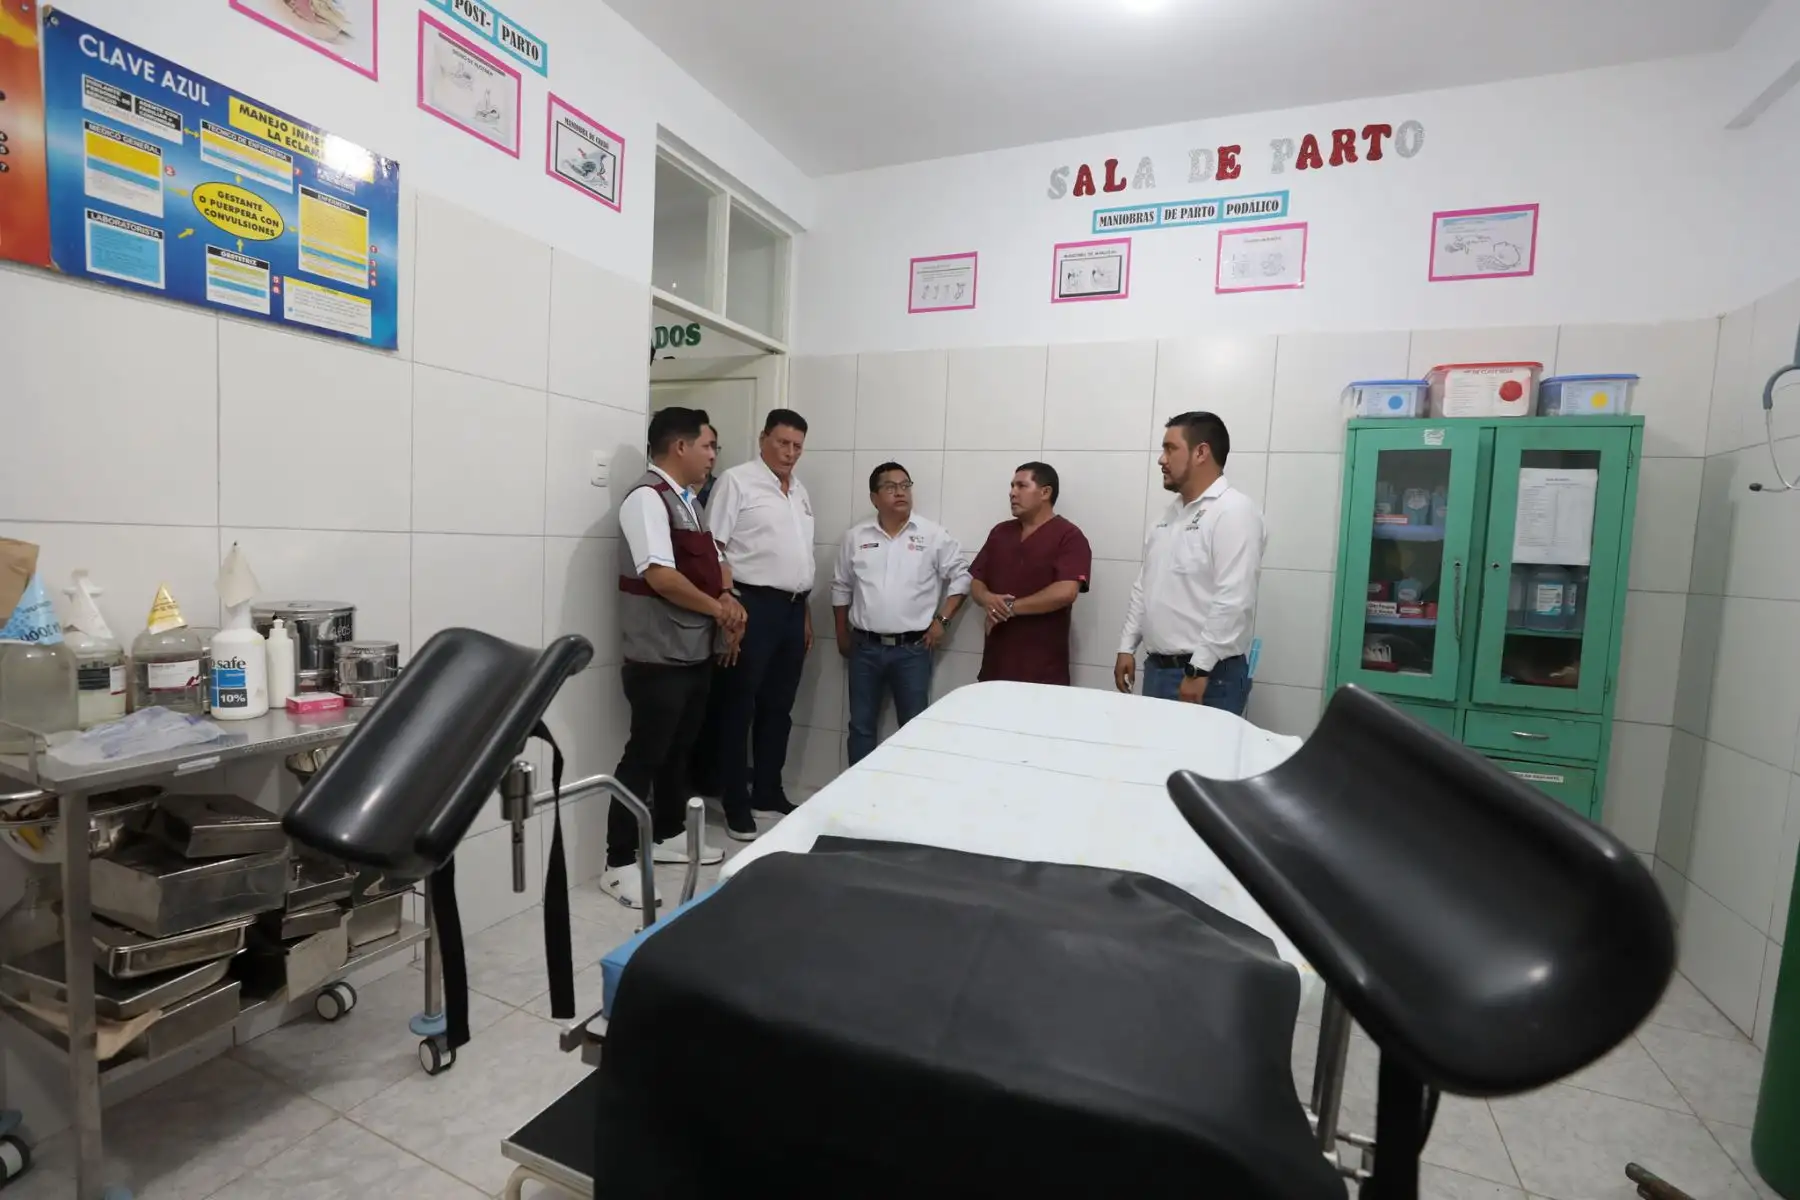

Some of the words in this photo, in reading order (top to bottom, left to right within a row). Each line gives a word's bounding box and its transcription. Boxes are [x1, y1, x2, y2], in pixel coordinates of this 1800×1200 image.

[455, 0, 491, 27] POST-
[502, 25, 539, 60] PARTO
[79, 34, 155, 83] CLAVE
[161, 70, 210, 106] AZUL
[239, 104, 289, 132] MANEJO
[123, 135, 160, 155] GENERAL
[237, 135, 247, 147] DE
[267, 128, 282, 143] LA
[1047, 156, 1157, 200] SALA
[1187, 144, 1242, 184] DE
[1269, 119, 1425, 175] PARTO
[199, 195, 206, 203] O
[209, 198, 258, 221] PUERPERA
[260, 215, 279, 228] CON
[217, 191, 263, 212] GESTANTE
[1099, 210, 1154, 228] MANIOBRAS
[1164, 208, 1178, 221] DE
[1179, 204, 1215, 220] PARTO
[1226, 198, 1280, 216] PODÁLICO
[90, 211, 161, 238] LABORATORISTA
[203, 208, 275, 237] CONVULSIONES
[655, 322, 701, 349] DOS
[220, 694, 246, 703] 10%
